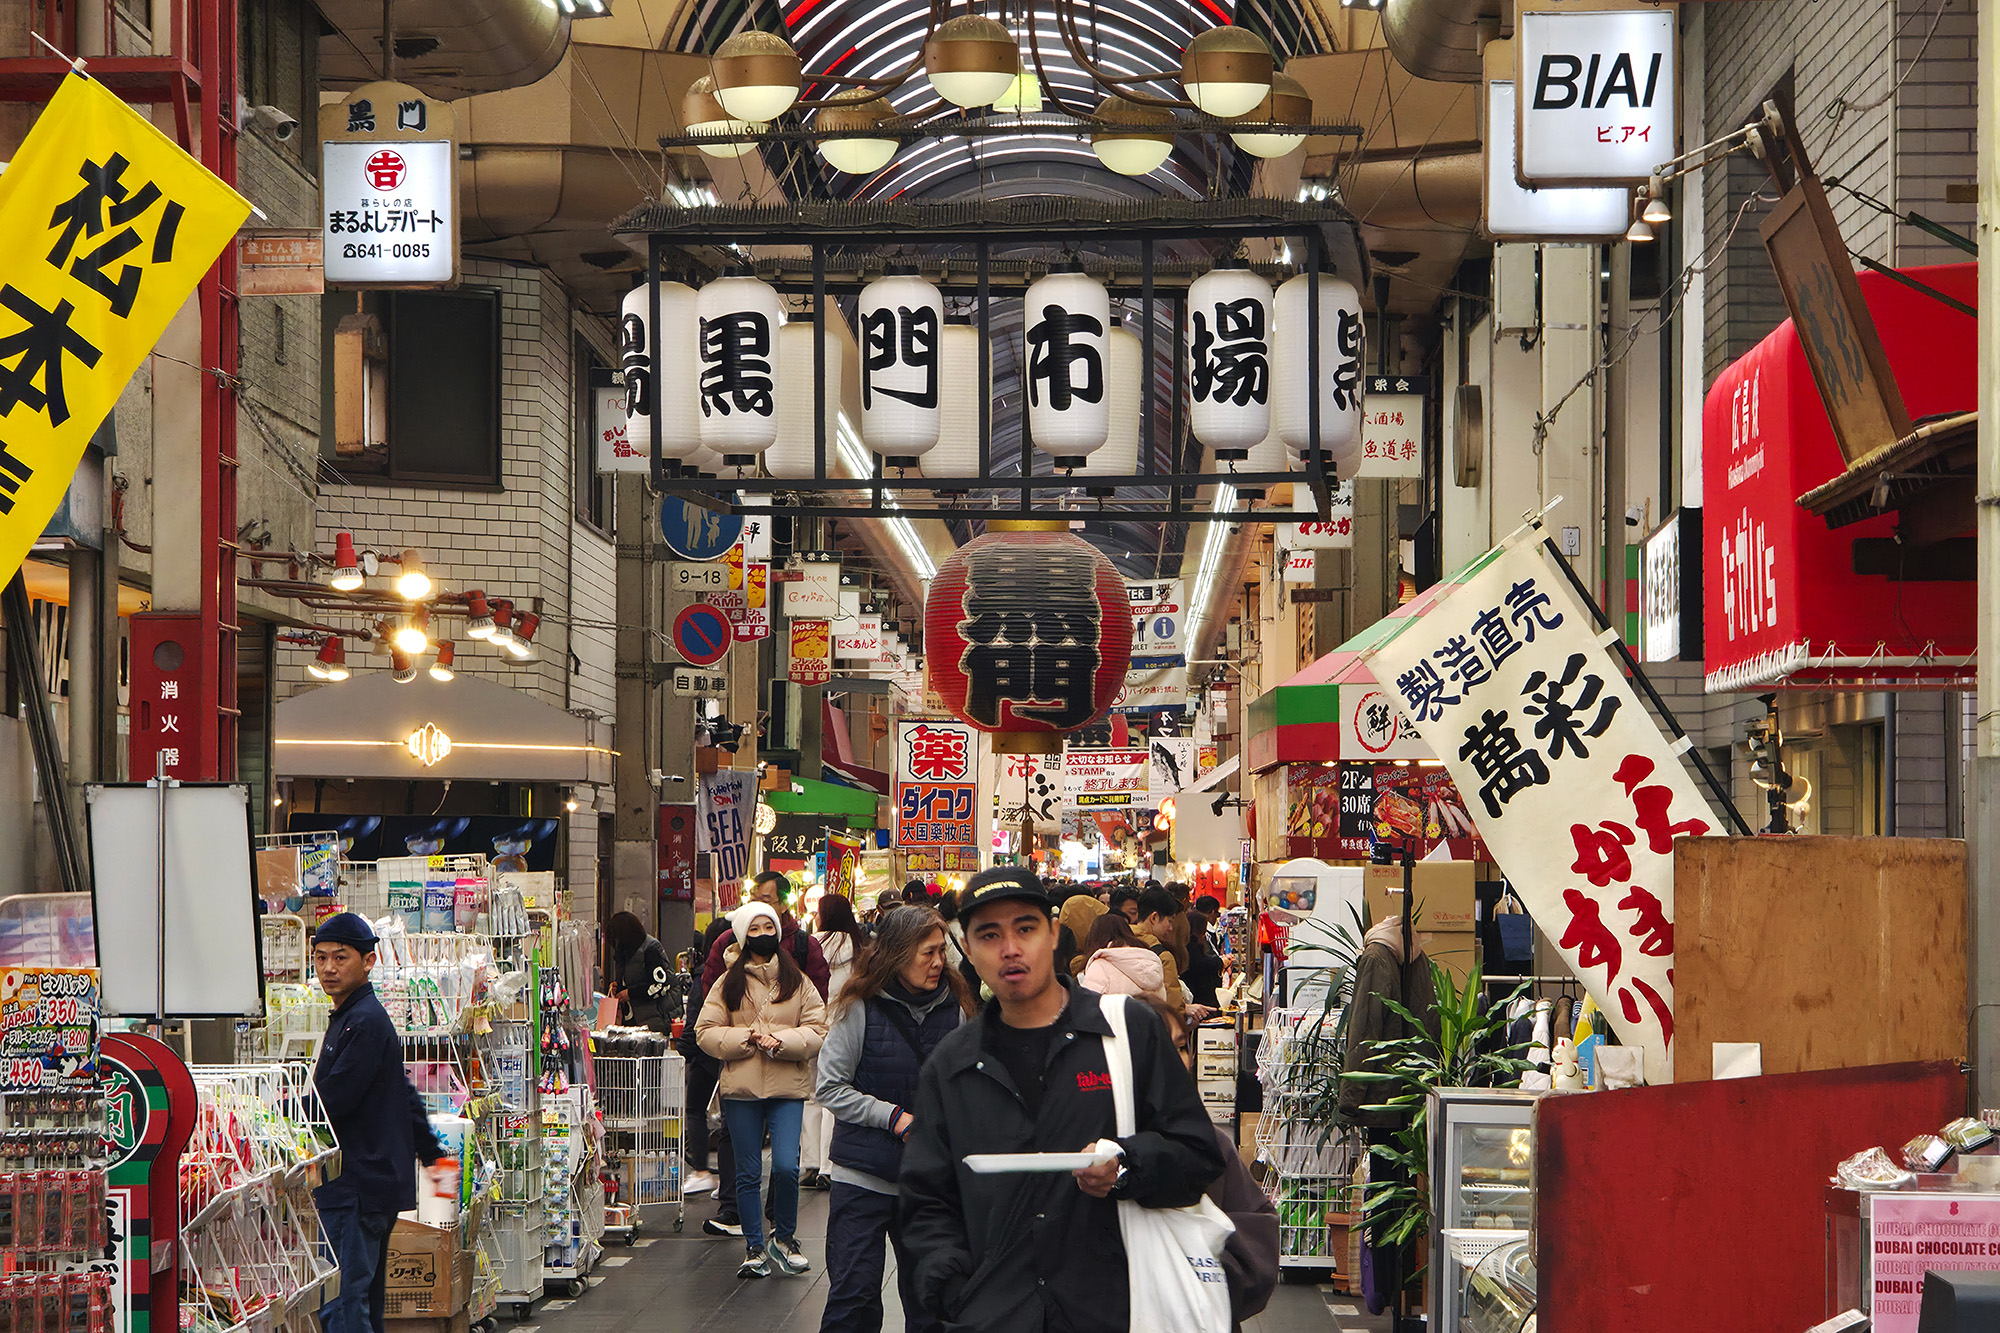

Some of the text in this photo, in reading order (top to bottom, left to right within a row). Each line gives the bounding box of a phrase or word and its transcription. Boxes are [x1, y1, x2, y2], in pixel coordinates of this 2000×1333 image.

[1533, 53, 1662, 109] BIAI
[346, 98, 428, 133] 黒門
[361, 198, 413, 208] 暮らしの店
[329, 210, 444, 234] まるよしデパート
[357, 244, 430, 258] 641-0085
[680, 569, 721, 584] 9-18
[1396, 577, 1564, 724] 製造直売
[676, 675, 725, 691] 自動車
[1129, 686, 1179, 695] バイク通行禁止
[905, 724, 968, 779] 薬
[1069, 754, 1132, 764] 大切なお知らせ
[1071, 767, 1106, 776] STAMP
[1084, 777, 1140, 790] 終了します
[1342, 771, 1359, 789] 2F
[902, 786, 973, 820] ダイコク
[1342, 796, 1371, 814] 30席
[707, 808, 744, 847] SEA
[2, 1008, 35, 1030] JAPAN
[1875, 1222, 1914, 1237] DUBAI
[1915, 1222, 1987, 1238] CHOCOLATE
[1875, 1241, 1913, 1255] DUBAI
[1916, 1241, 1985, 1256] CHOCOLATE
[1875, 1260, 1914, 1275] DUBAI
[1875, 1281, 1913, 1294] DUBAI
[1875, 1300, 1914, 1315] DUBAI
